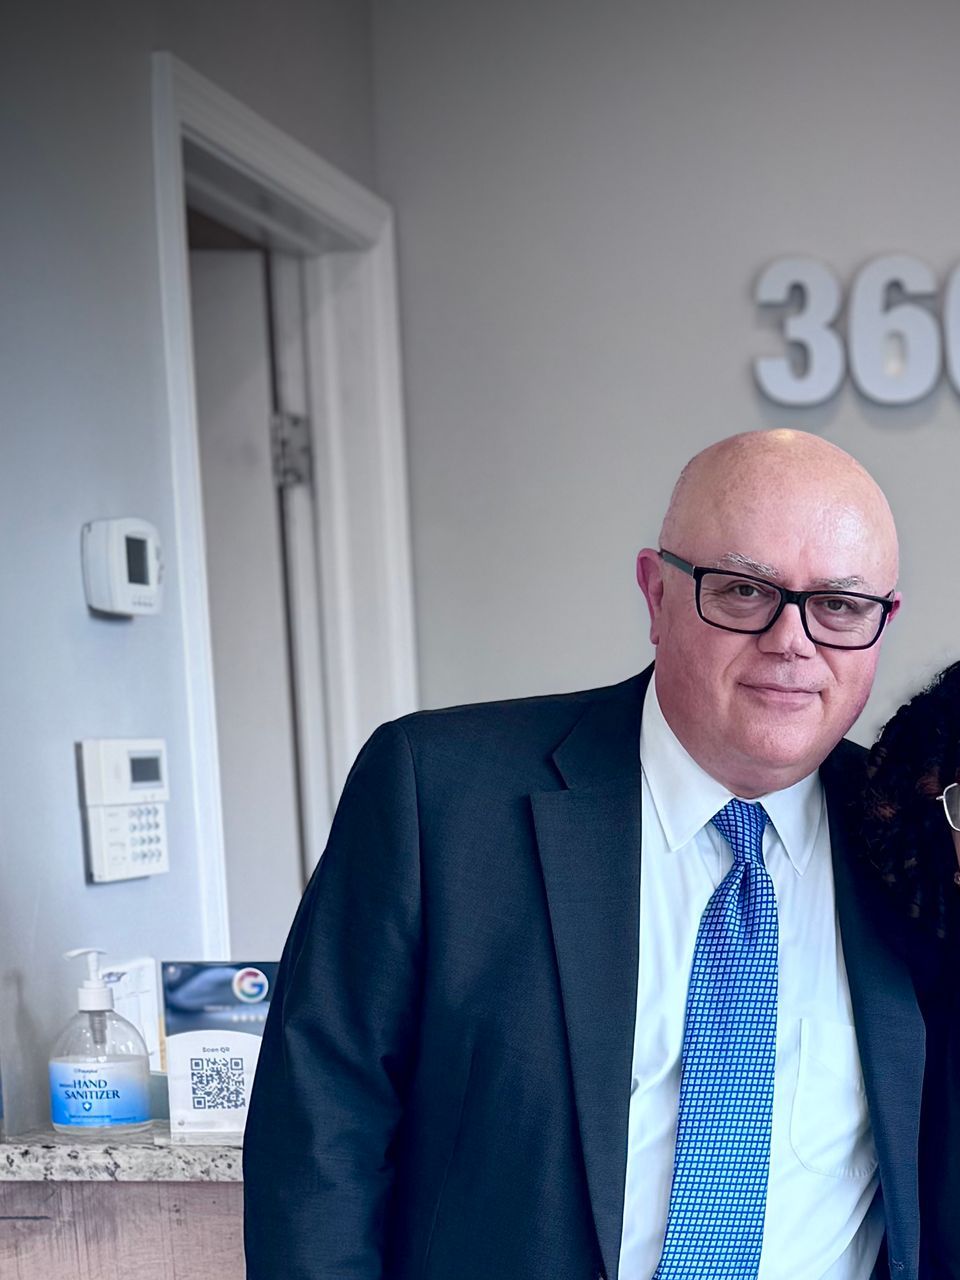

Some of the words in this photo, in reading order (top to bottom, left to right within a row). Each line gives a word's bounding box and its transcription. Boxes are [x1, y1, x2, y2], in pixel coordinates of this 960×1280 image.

[236, 971, 265, 999] G
[73, 1079, 108, 1089] HAND
[64, 1089, 121, 1100] SANITIZER
